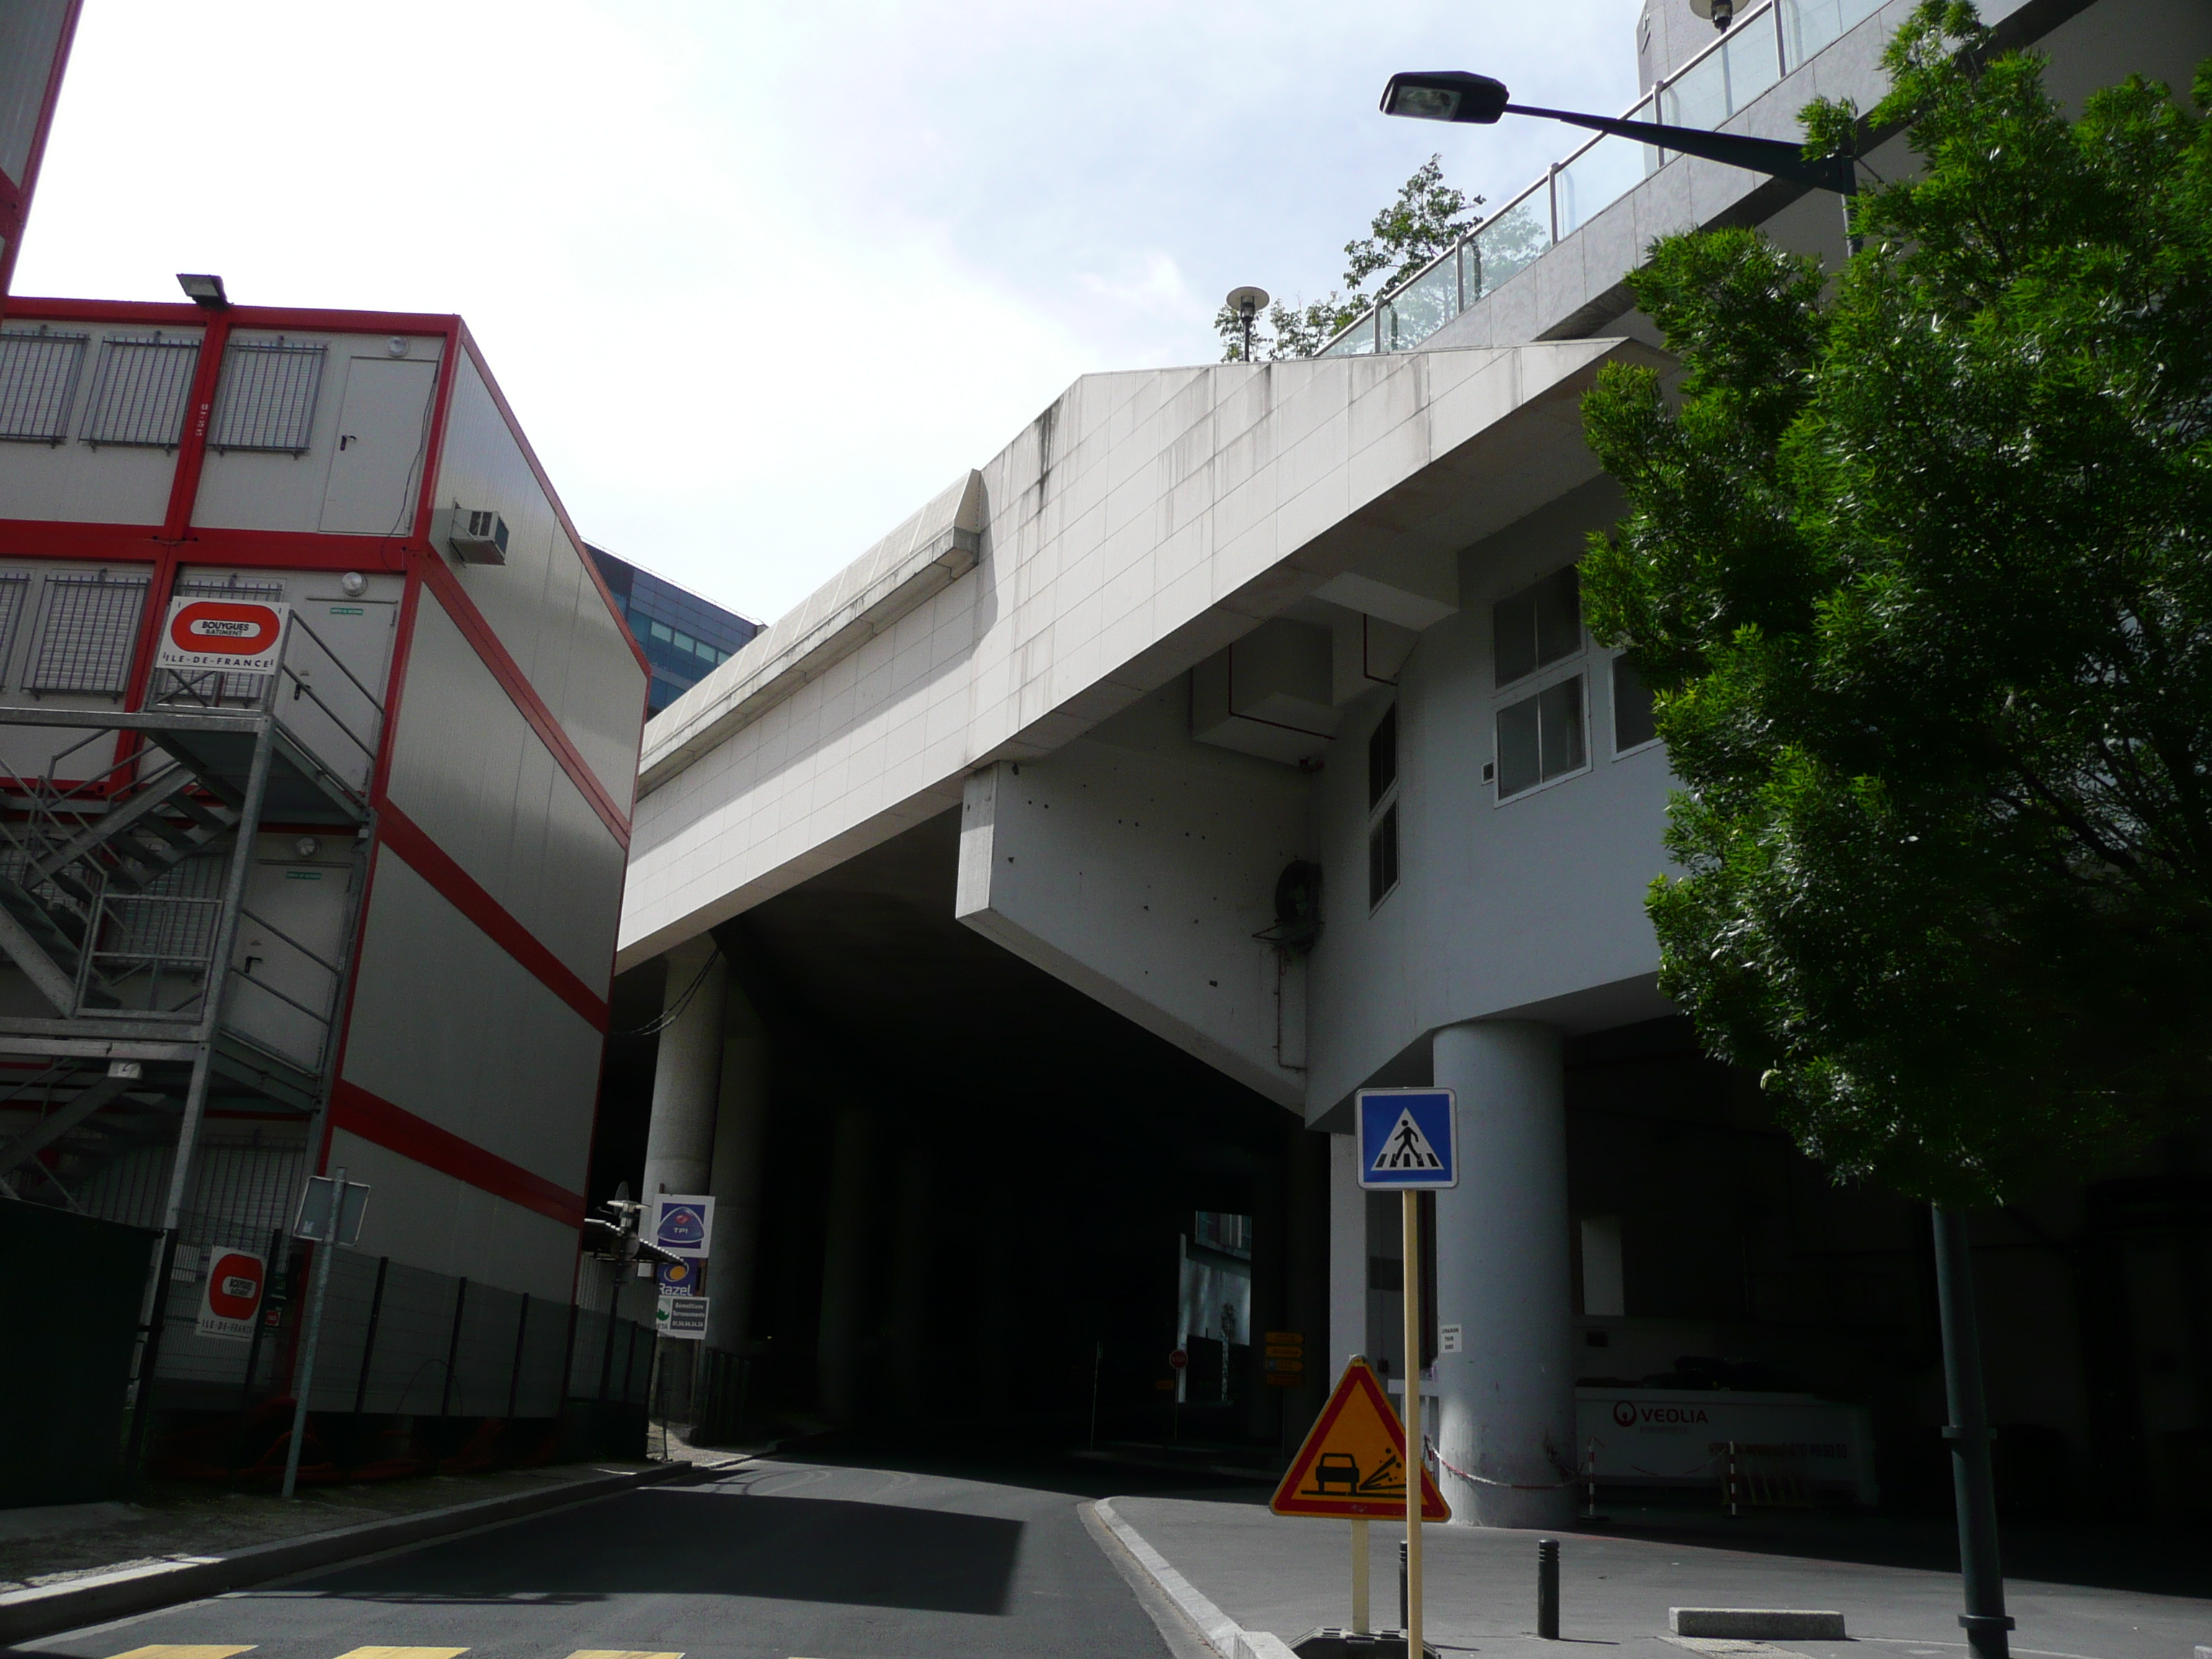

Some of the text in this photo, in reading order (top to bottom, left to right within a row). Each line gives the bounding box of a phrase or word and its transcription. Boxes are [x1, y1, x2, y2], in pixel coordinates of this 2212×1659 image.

[202, 621, 249, 631] BOUYGUES
[166, 655, 269, 667] ILE-DE-FRANCE
[202, 1319, 252, 1334] ILE-DE-FRANCE
[1640, 1408, 1709, 1424] VEOLIA
